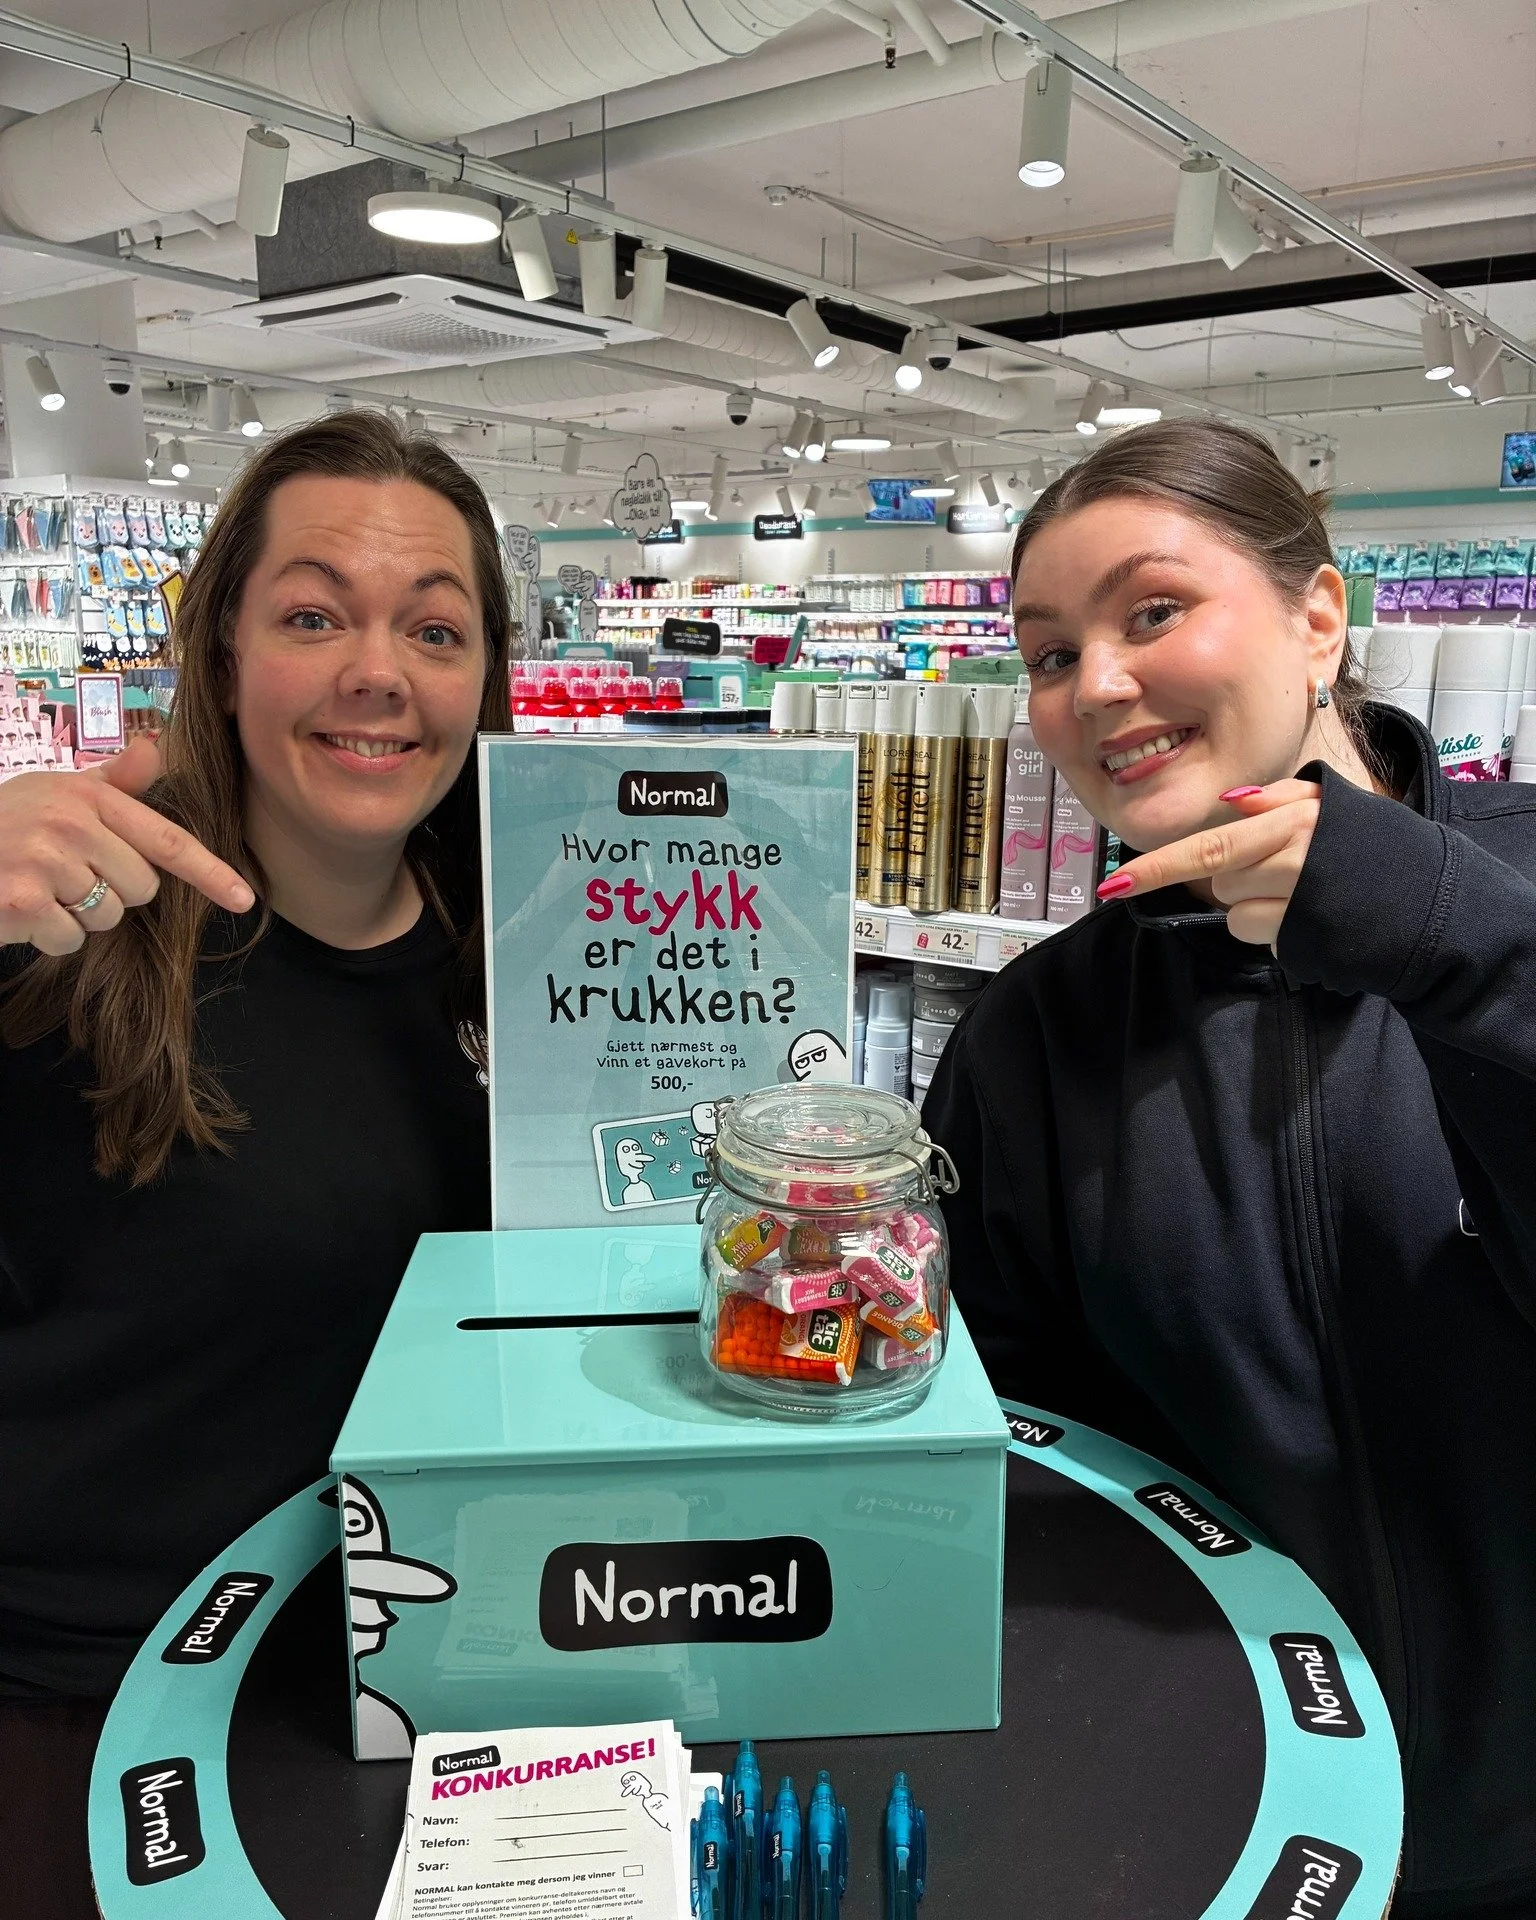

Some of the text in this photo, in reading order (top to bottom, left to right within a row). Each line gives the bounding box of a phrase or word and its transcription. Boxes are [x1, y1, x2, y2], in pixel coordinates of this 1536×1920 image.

[90, 706, 112, 717] Blush
[1437, 733, 1483, 756] tiste
[1018, 763, 1043, 776] girl
[631, 777, 715, 808] Normal
[909, 772, 931, 856] Elnett
[961, 774, 985, 858] Elnett
[562, 833, 782, 870] Hvor mange
[585, 870, 762, 935] stykk
[855, 921, 880, 938] 42,-
[941, 933, 969, 950] 42,-
[585, 931, 760, 971] er det i
[547, 973, 797, 1024] krukken?
[607, 1040, 738, 1055] Gjett nærmest og
[635, 1057, 651, 1068] et
[656, 1055, 726, 1069] gavekort
[731, 1057, 747, 1071] på
[650, 1075, 694, 1091] 500,-
[696, 1173, 712, 1186] Nor
[731, 1238, 747, 1253] MIX
[733, 1239, 759, 1265] FRUITY
[795, 1290, 828, 1305] STRAWBERRY
[811, 1314, 829, 1345] tac
[872, 1311, 904, 1329] ORANGE
[822, 1321, 839, 1349] tic
[1005, 1417, 1050, 1442] Nor
[1147, 1490, 1235, 1549] Normal
[574, 1560, 798, 1626] Normal
[181, 1581, 258, 1654] Normal
[1284, 1643, 1348, 1725] Normal
[431, 1738, 655, 1800] KONKURRANSE!
[439, 1751, 494, 1772] Normal
[734, 1793, 742, 1817] Normal
[137, 1769, 188, 1868] Normal
[422, 1815, 459, 1827] Navn:
[420, 1836, 470, 1849] Telefon:
[772, 1833, 780, 1859] Normal
[417, 1861, 449, 1873] Svar:
[705, 1844, 715, 1868] Normal
[414, 1886, 455, 1895] NORMAL
[457, 1884, 473, 1892] kan
[475, 1880, 514, 1890] kontakte
[538, 1876, 571, 1884] dersom
[572, 1874, 586, 1883] jeg
[588, 1871, 616, 1879] vinner
[1286, 1848, 1341, 1920] rmal
[411, 1910, 464, 1919] telefonnummer
[578, 1894, 618, 1903] umiddelbart
[413, 1896, 453, 1905] Betingelser:
[462, 1899, 504, 1908] opplysninger
[518, 1889, 599, 1903] konkurranse-deltakerens
[542, 1907, 572, 1915] avhentes
[591, 1901, 622, 1909] nærmere
